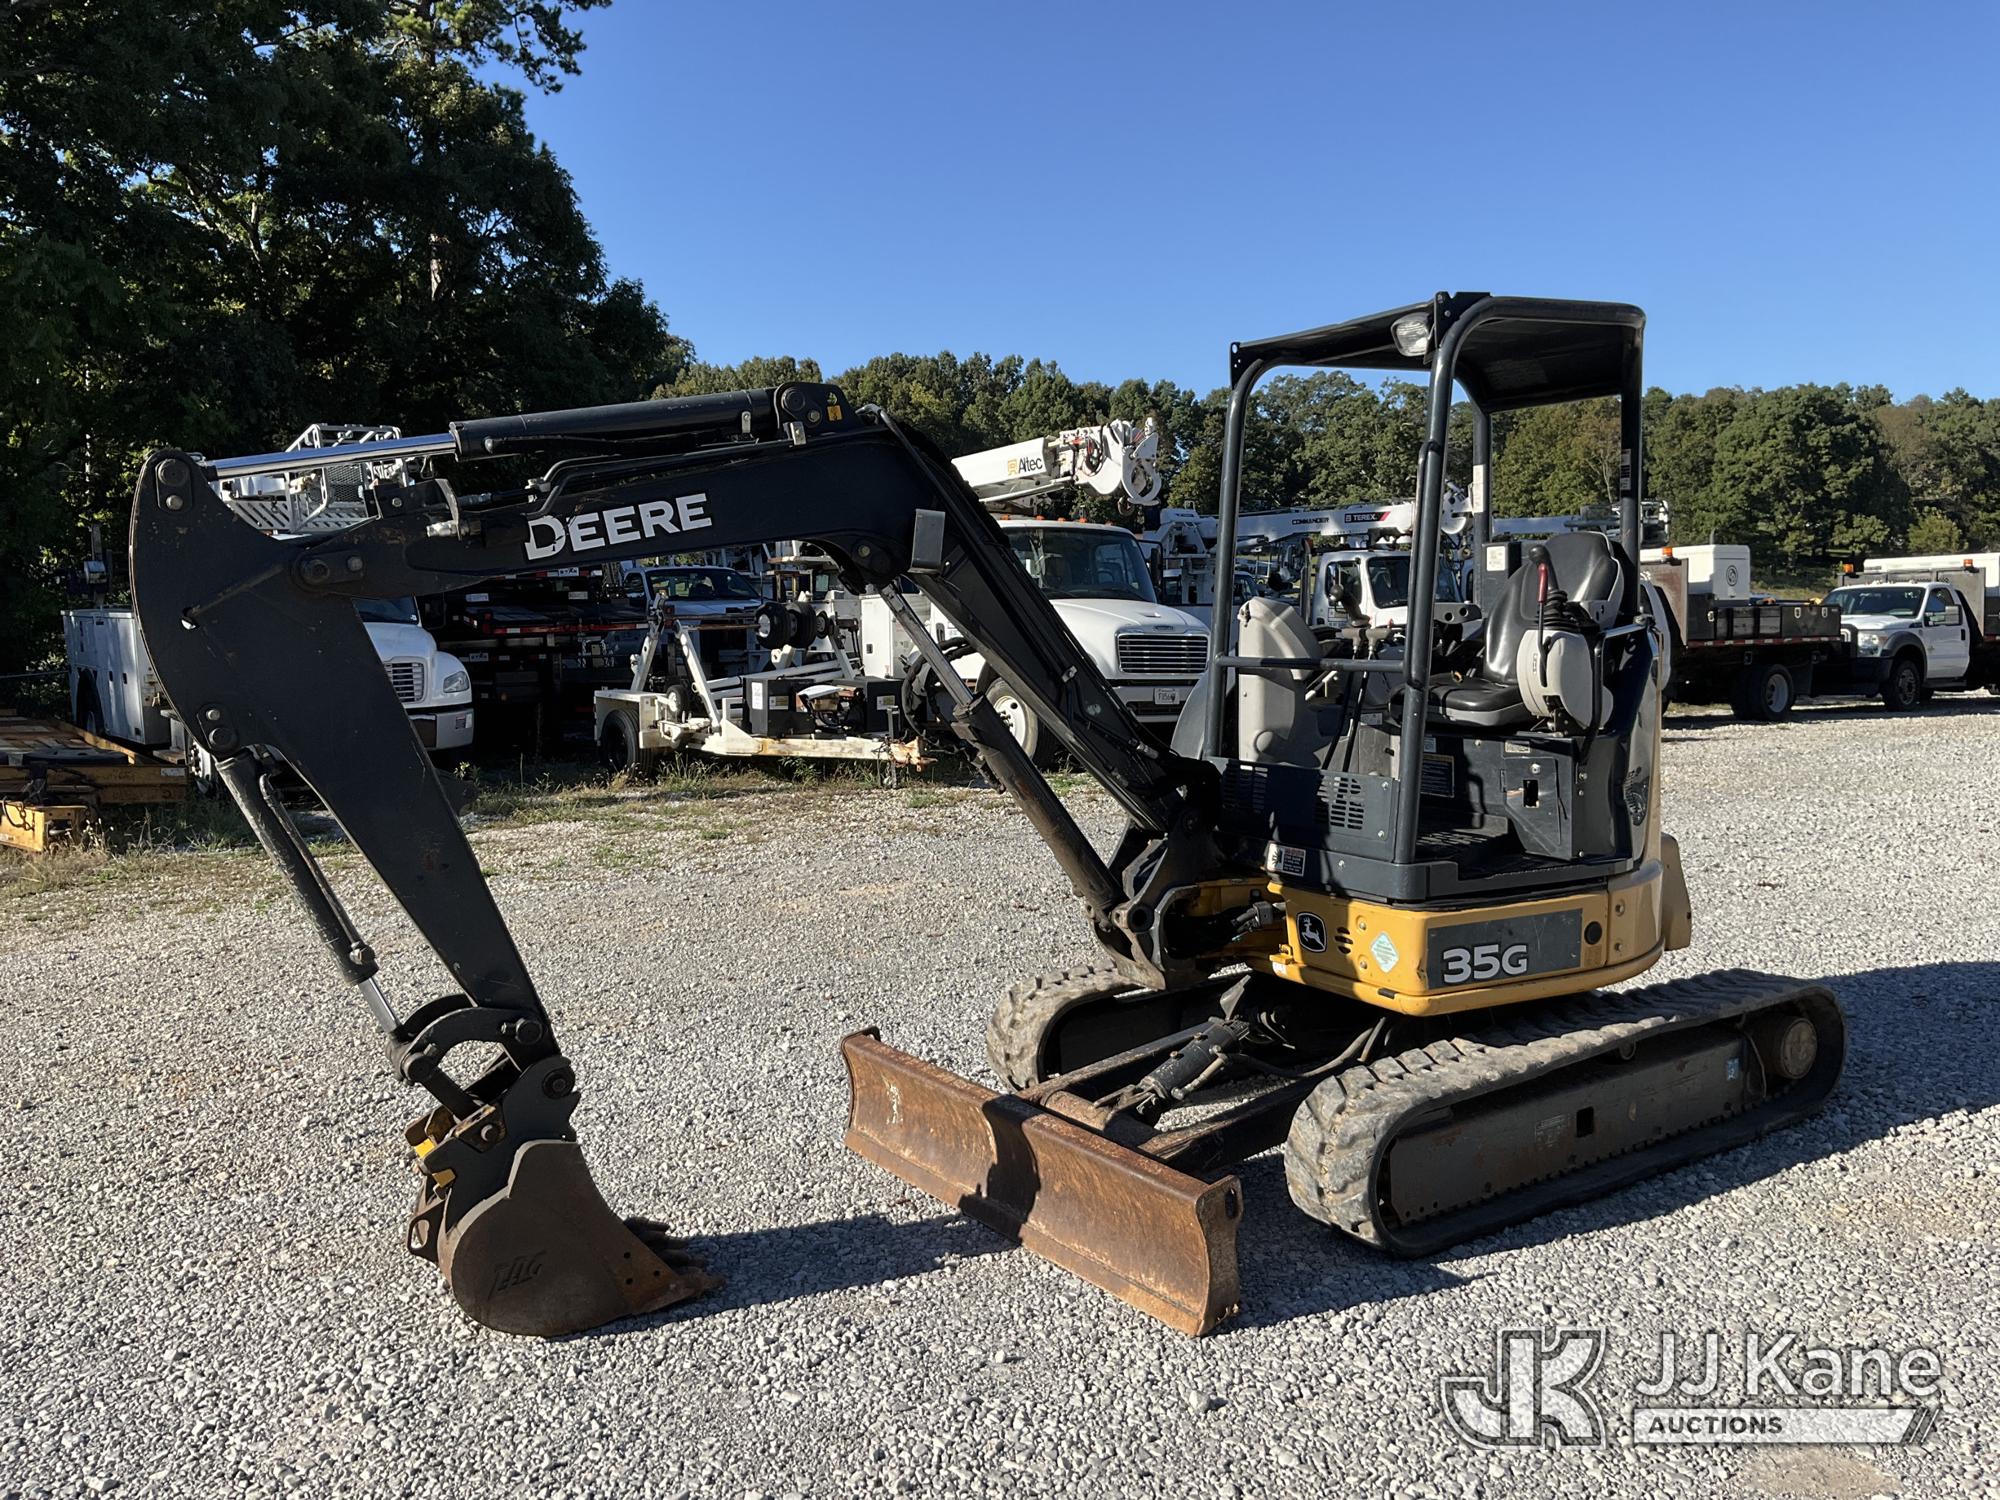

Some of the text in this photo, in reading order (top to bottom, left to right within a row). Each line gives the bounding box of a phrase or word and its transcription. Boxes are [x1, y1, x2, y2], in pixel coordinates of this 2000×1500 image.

[1018, 456, 1043, 474] Altec
[524, 492, 712, 561] DEERE
[1352, 513, 1377, 521] TEREX
[1443, 944, 1528, 984] 35G
